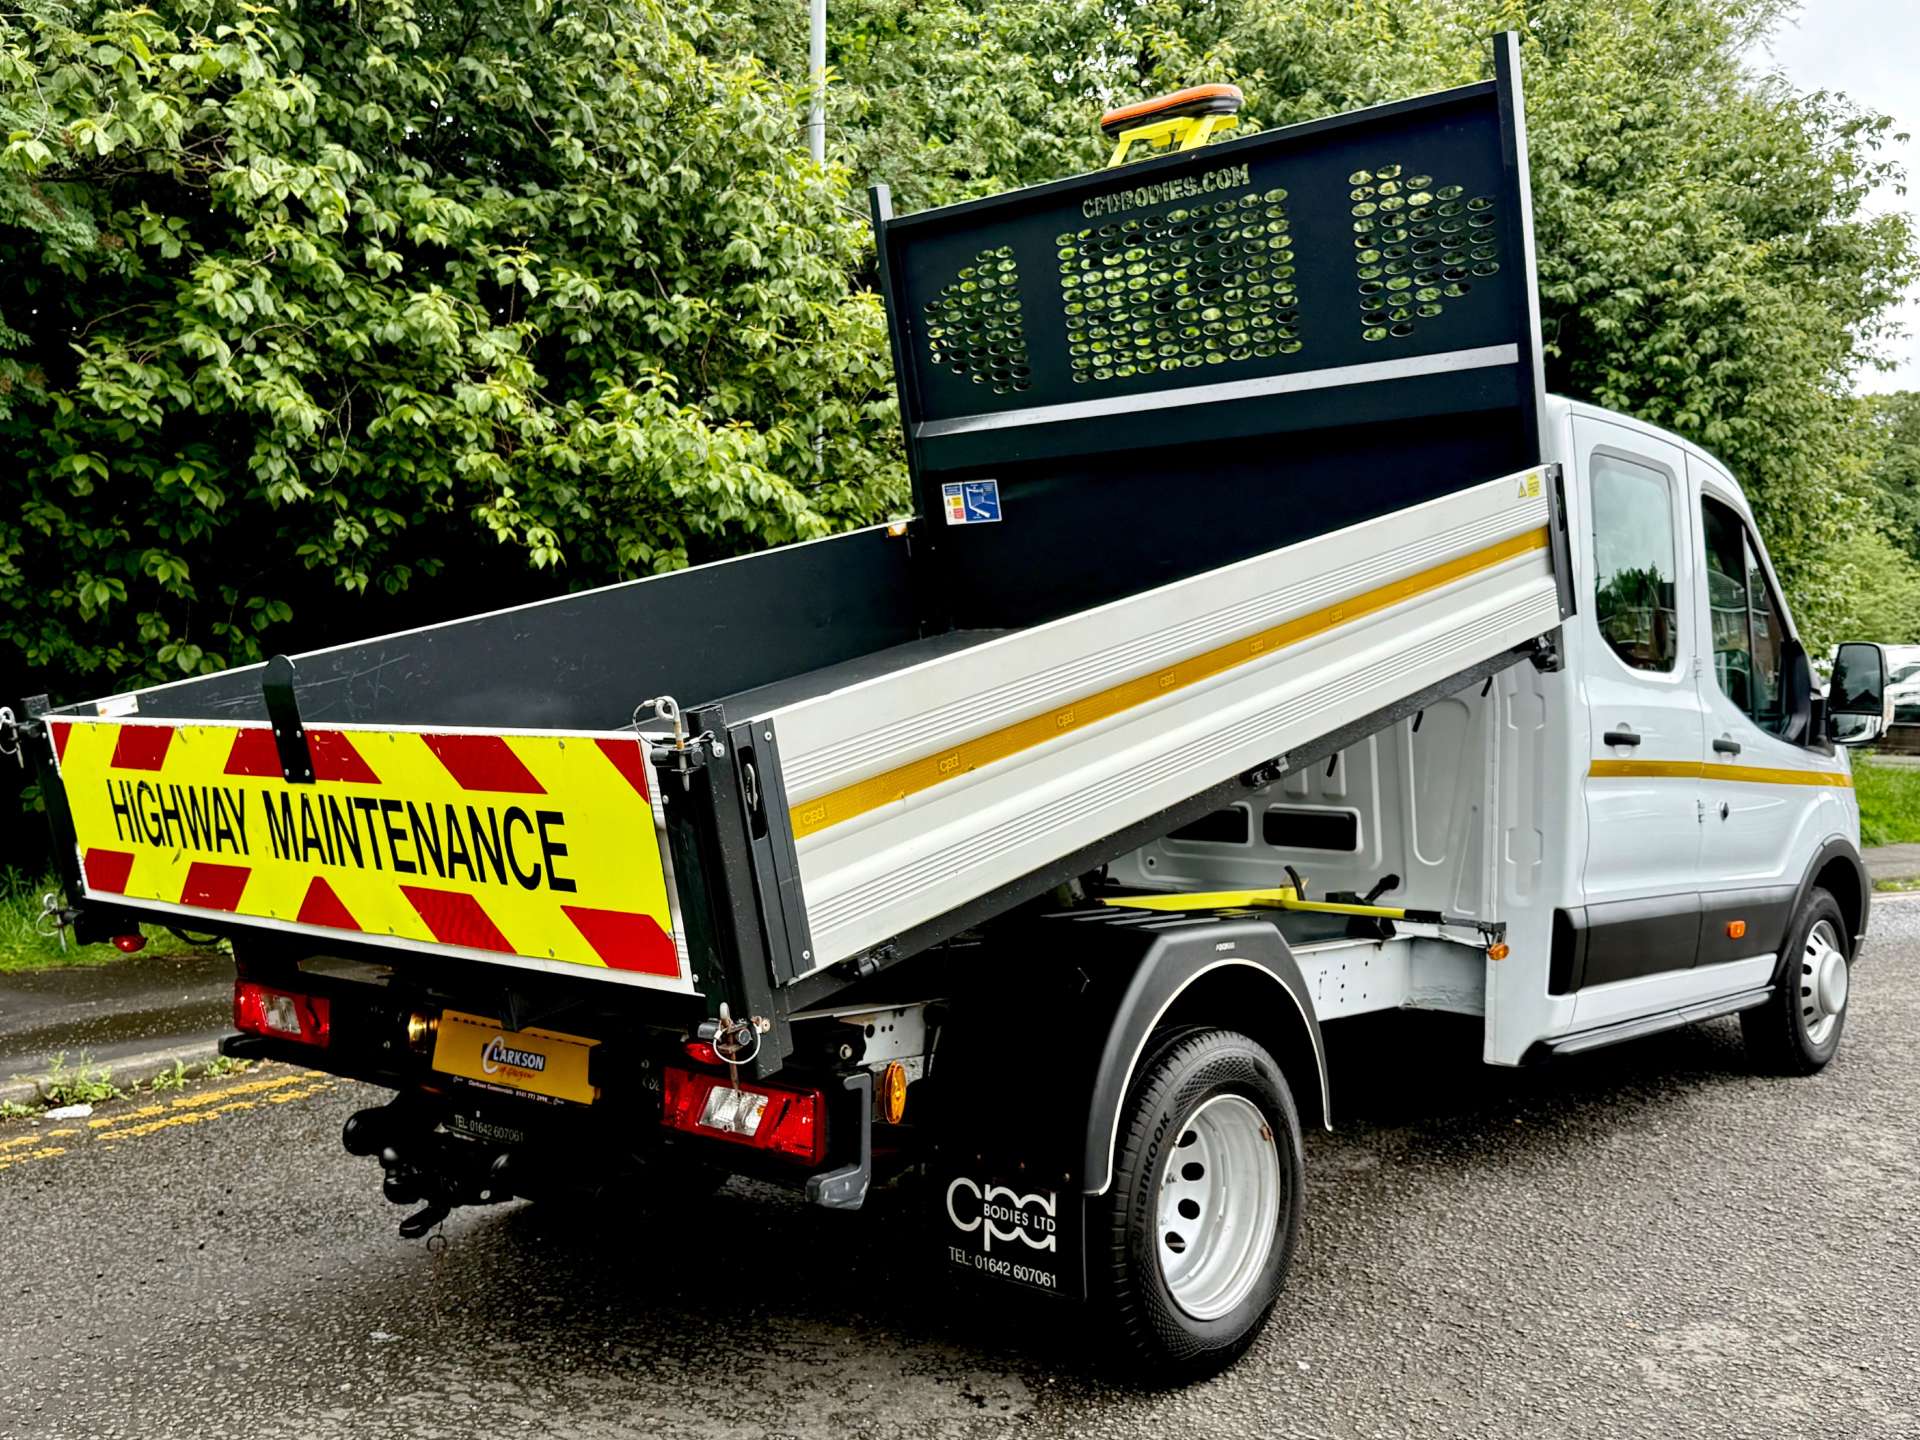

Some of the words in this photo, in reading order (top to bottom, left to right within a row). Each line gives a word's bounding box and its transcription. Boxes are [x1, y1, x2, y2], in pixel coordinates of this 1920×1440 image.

[106, 779, 250, 856] HIGHWAY
[262, 790, 577, 893] MAINTENANCE
[483, 1036, 545, 1074] CLARKSON
[469, 1120, 492, 1136] 01642
[493, 1126, 524, 1142] 607061
[984, 1203, 1029, 1226] BODIES
[1034, 1215, 1056, 1232] LTD
[975, 1254, 1011, 1277] 01642
[1013, 1264, 1057, 1289] 607061
